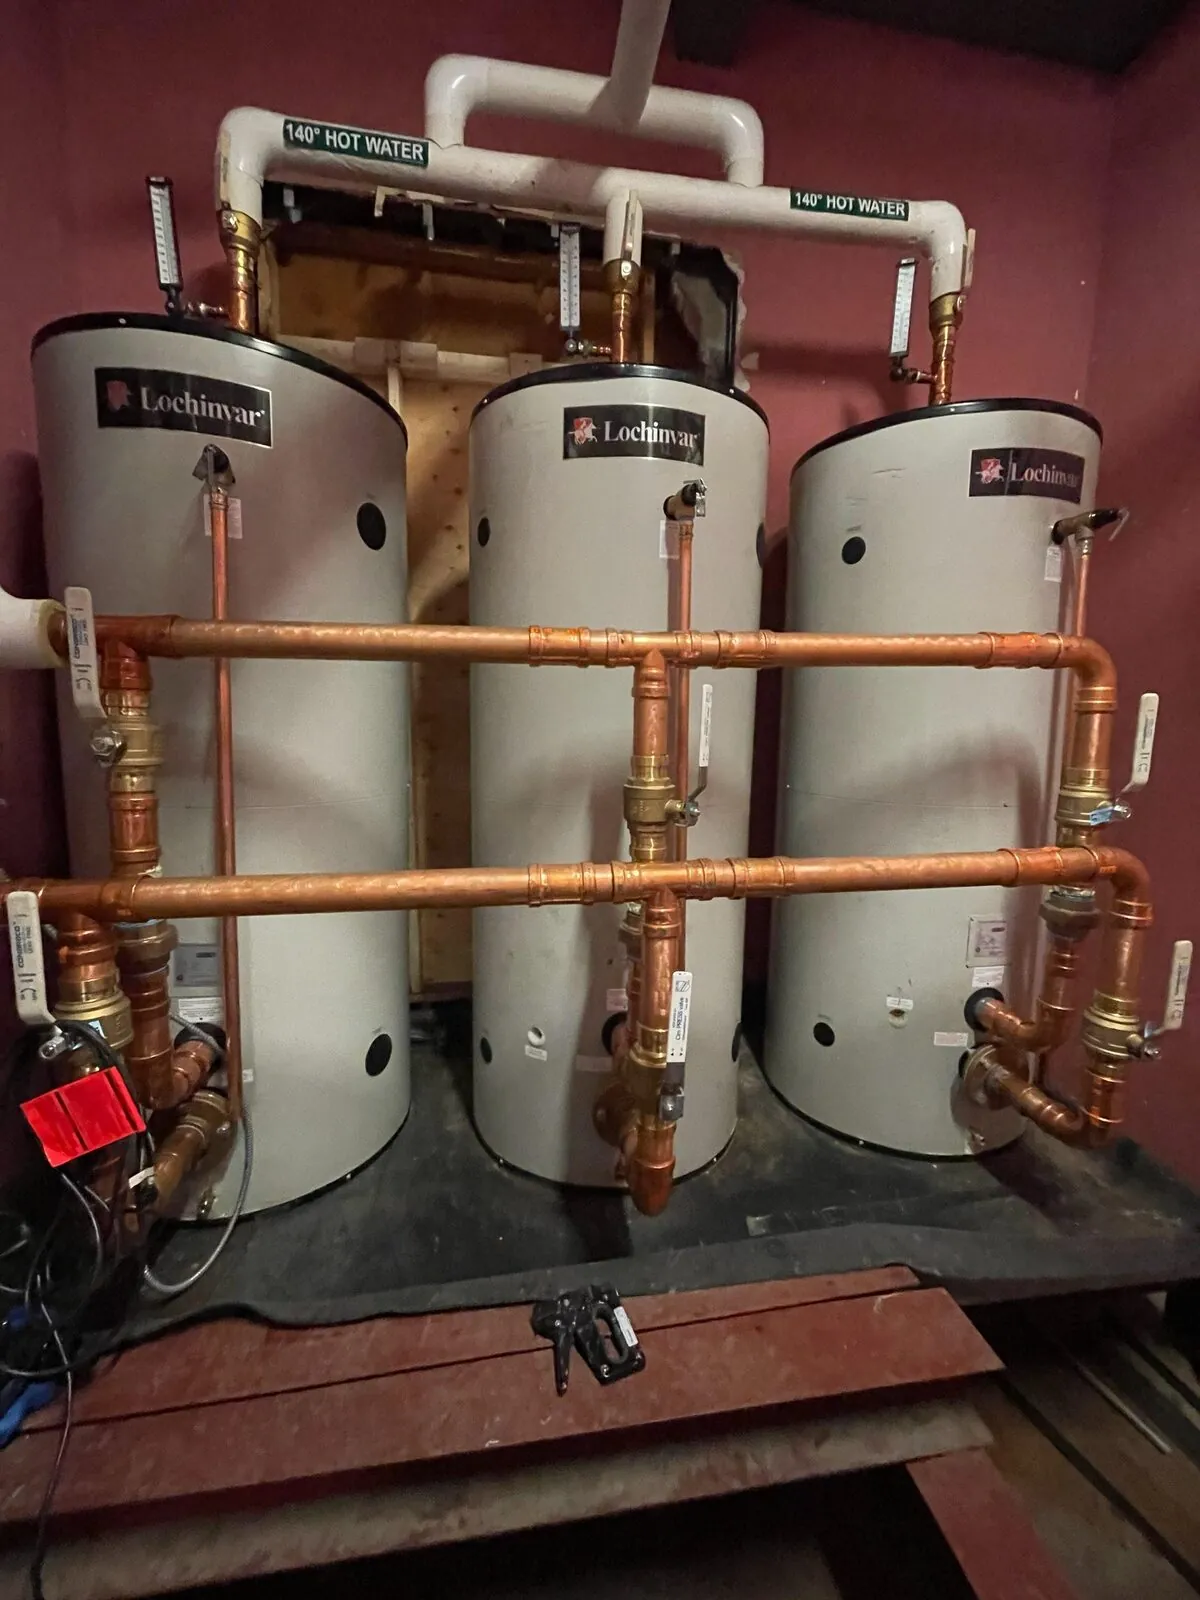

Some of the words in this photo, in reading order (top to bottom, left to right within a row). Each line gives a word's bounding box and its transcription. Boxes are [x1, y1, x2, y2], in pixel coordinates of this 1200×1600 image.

[285, 122, 321, 145] 140°
[325, 128, 361, 151] HOT
[365, 135, 425, 161] WATER
[795, 191, 823, 207] 140°
[826, 194, 855, 211] HOT
[858, 198, 905, 217] WATER
[140, 386, 264, 427] Lochinvar
[604, 420, 698, 448] Lochinvar
